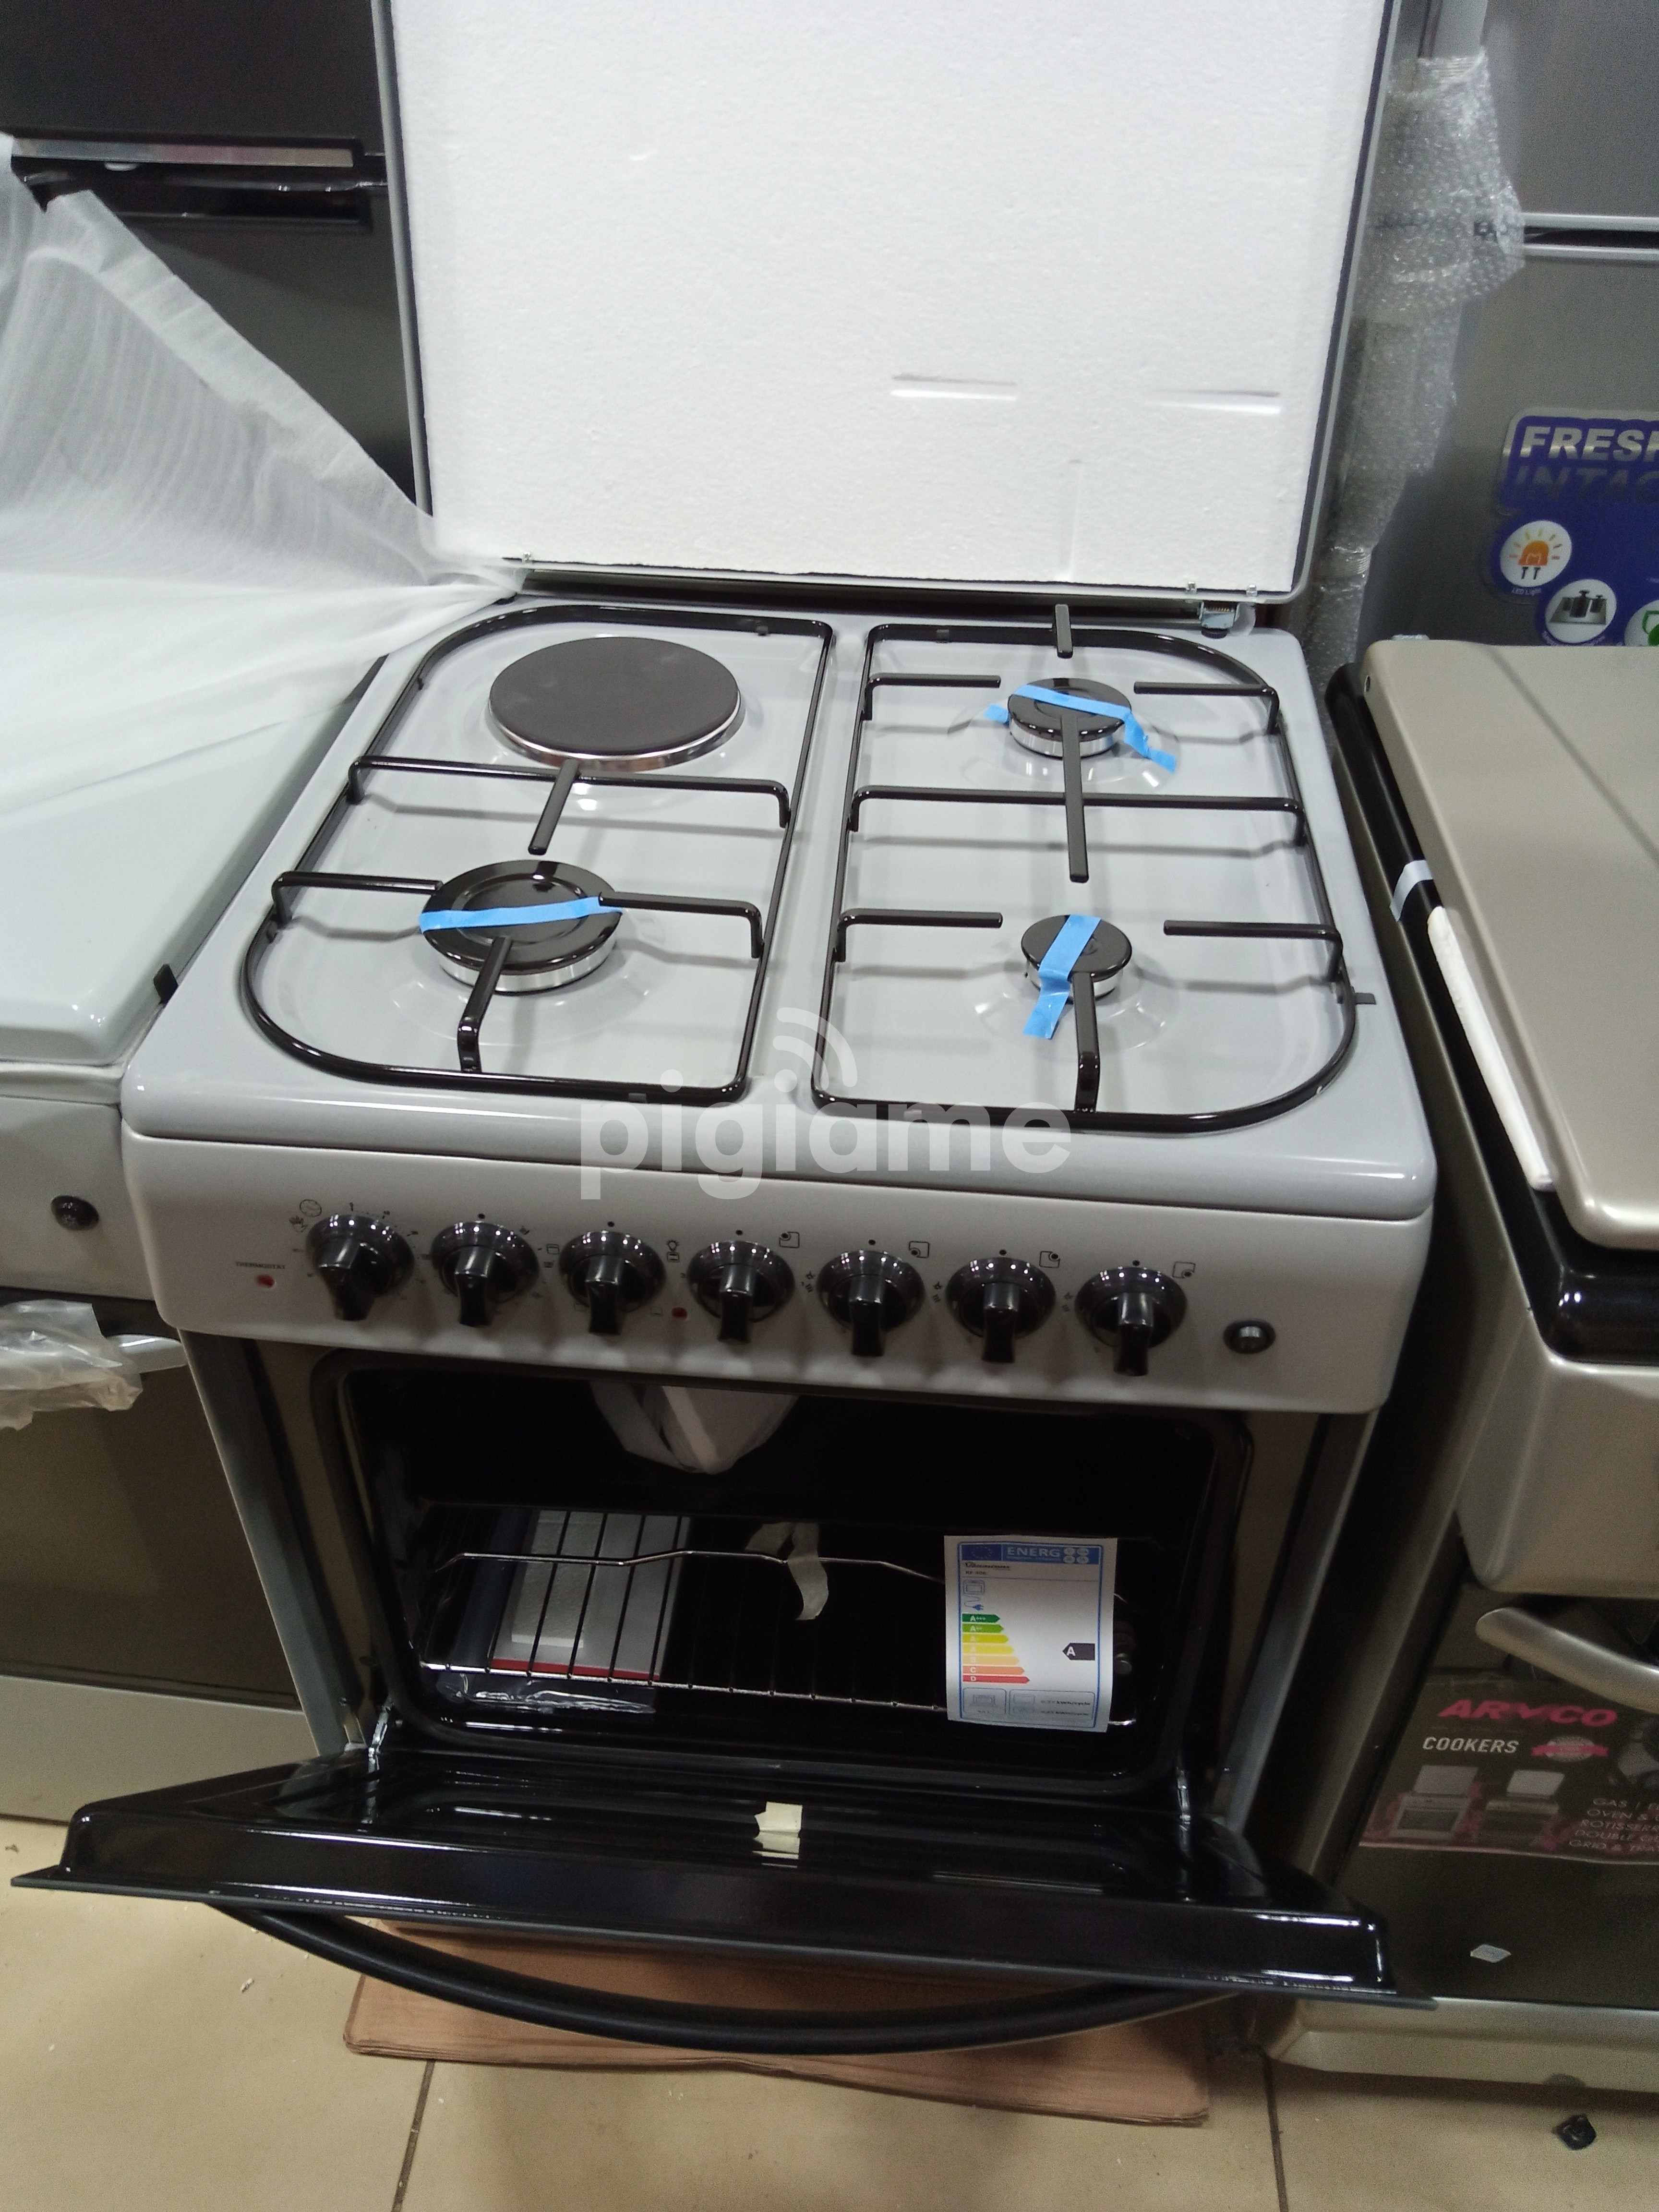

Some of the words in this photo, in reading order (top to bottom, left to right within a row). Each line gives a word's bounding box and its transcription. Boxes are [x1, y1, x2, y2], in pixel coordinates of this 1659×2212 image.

[1007, 1547, 1060, 1558] ENERG
[1066, 1646, 1076, 1657] A
[1422, 1736, 1519, 1754] COOKERS
[1592, 1797, 1628, 1808] GAS
[1587, 1808, 1633, 1819] OVEN
